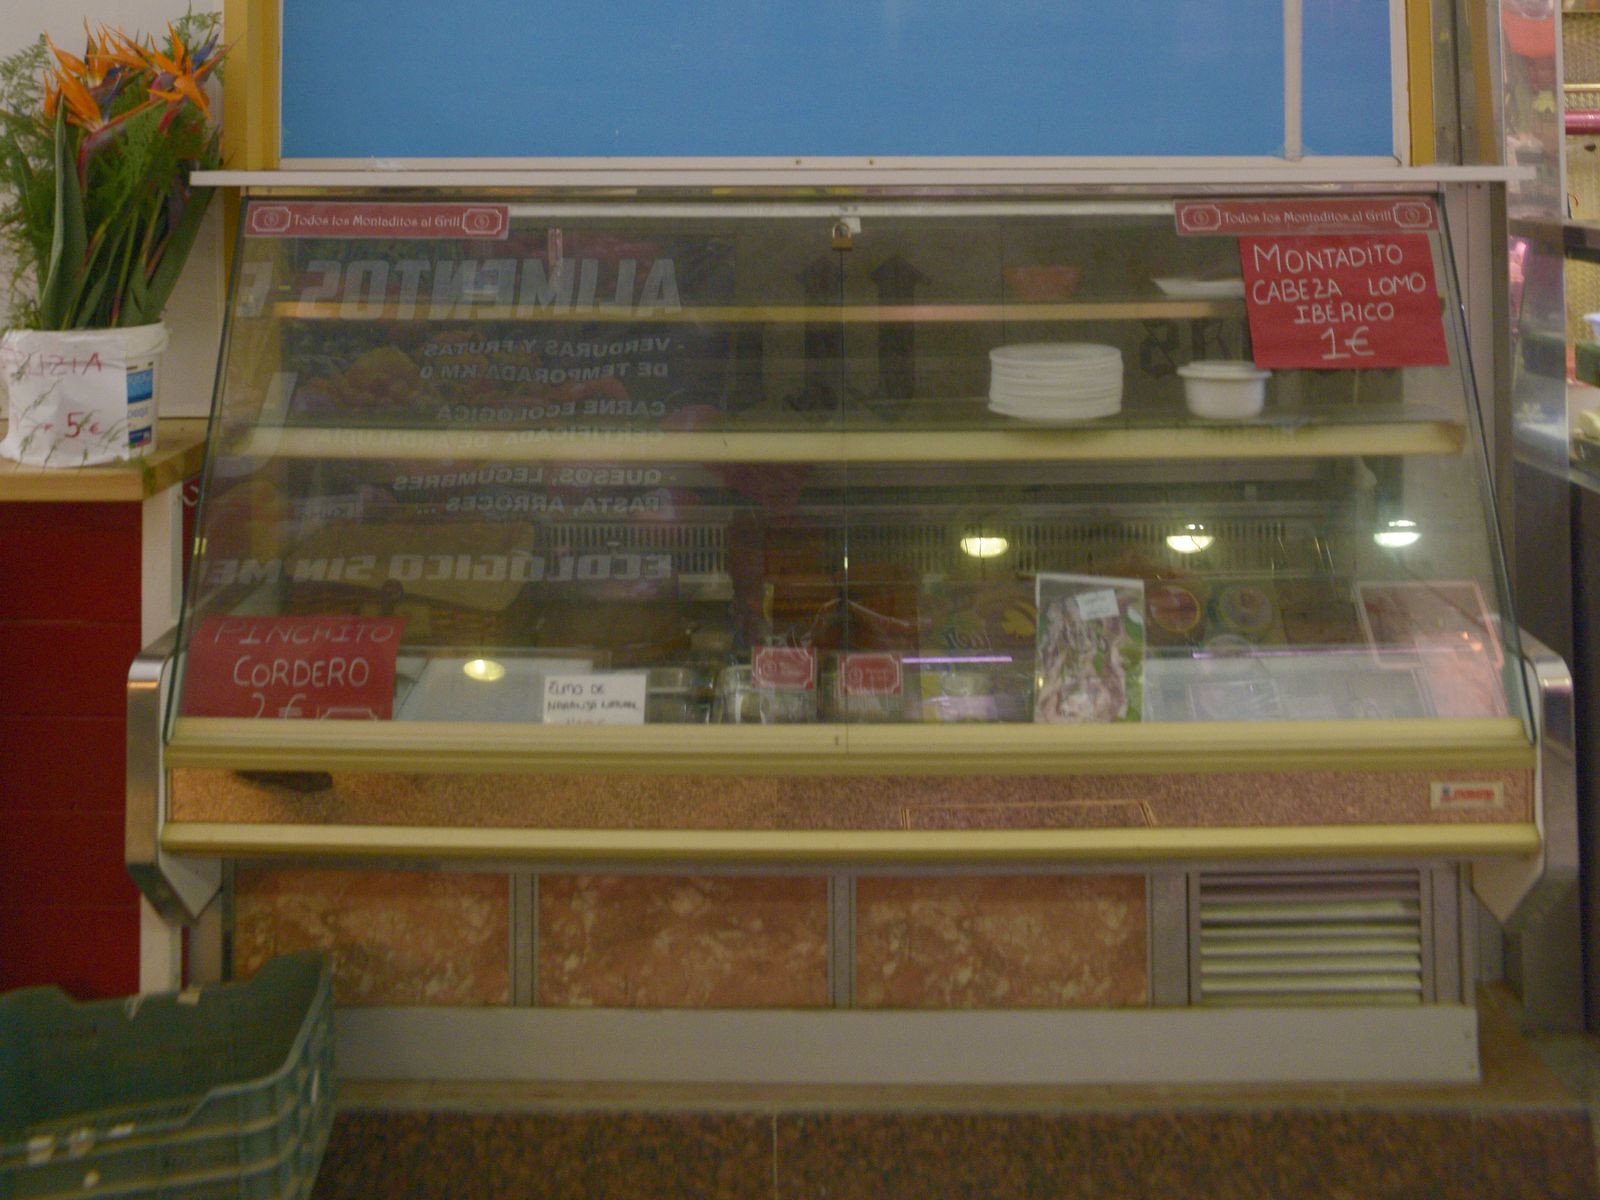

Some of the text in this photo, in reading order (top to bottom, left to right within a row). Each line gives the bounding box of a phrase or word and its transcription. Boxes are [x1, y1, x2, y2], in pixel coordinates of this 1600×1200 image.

[294, 212, 329, 227] Todos
[331, 213, 350, 227] los
[353, 212, 419, 228] Montaditos
[434, 212, 461, 228] Grill
[1223, 211, 1260, 225] Todos
[1263, 210, 1281, 224] los
[1284, 209, 1351, 225] Montaditos
[1365, 209, 1393, 223] Grill
[1253, 241, 1403, 274] MONTADITO
[1253, 272, 1427, 305] CABEZA LOMO
[1321, 326, 1375, 360] 1€
[233, 654, 370, 689] CORDERO
